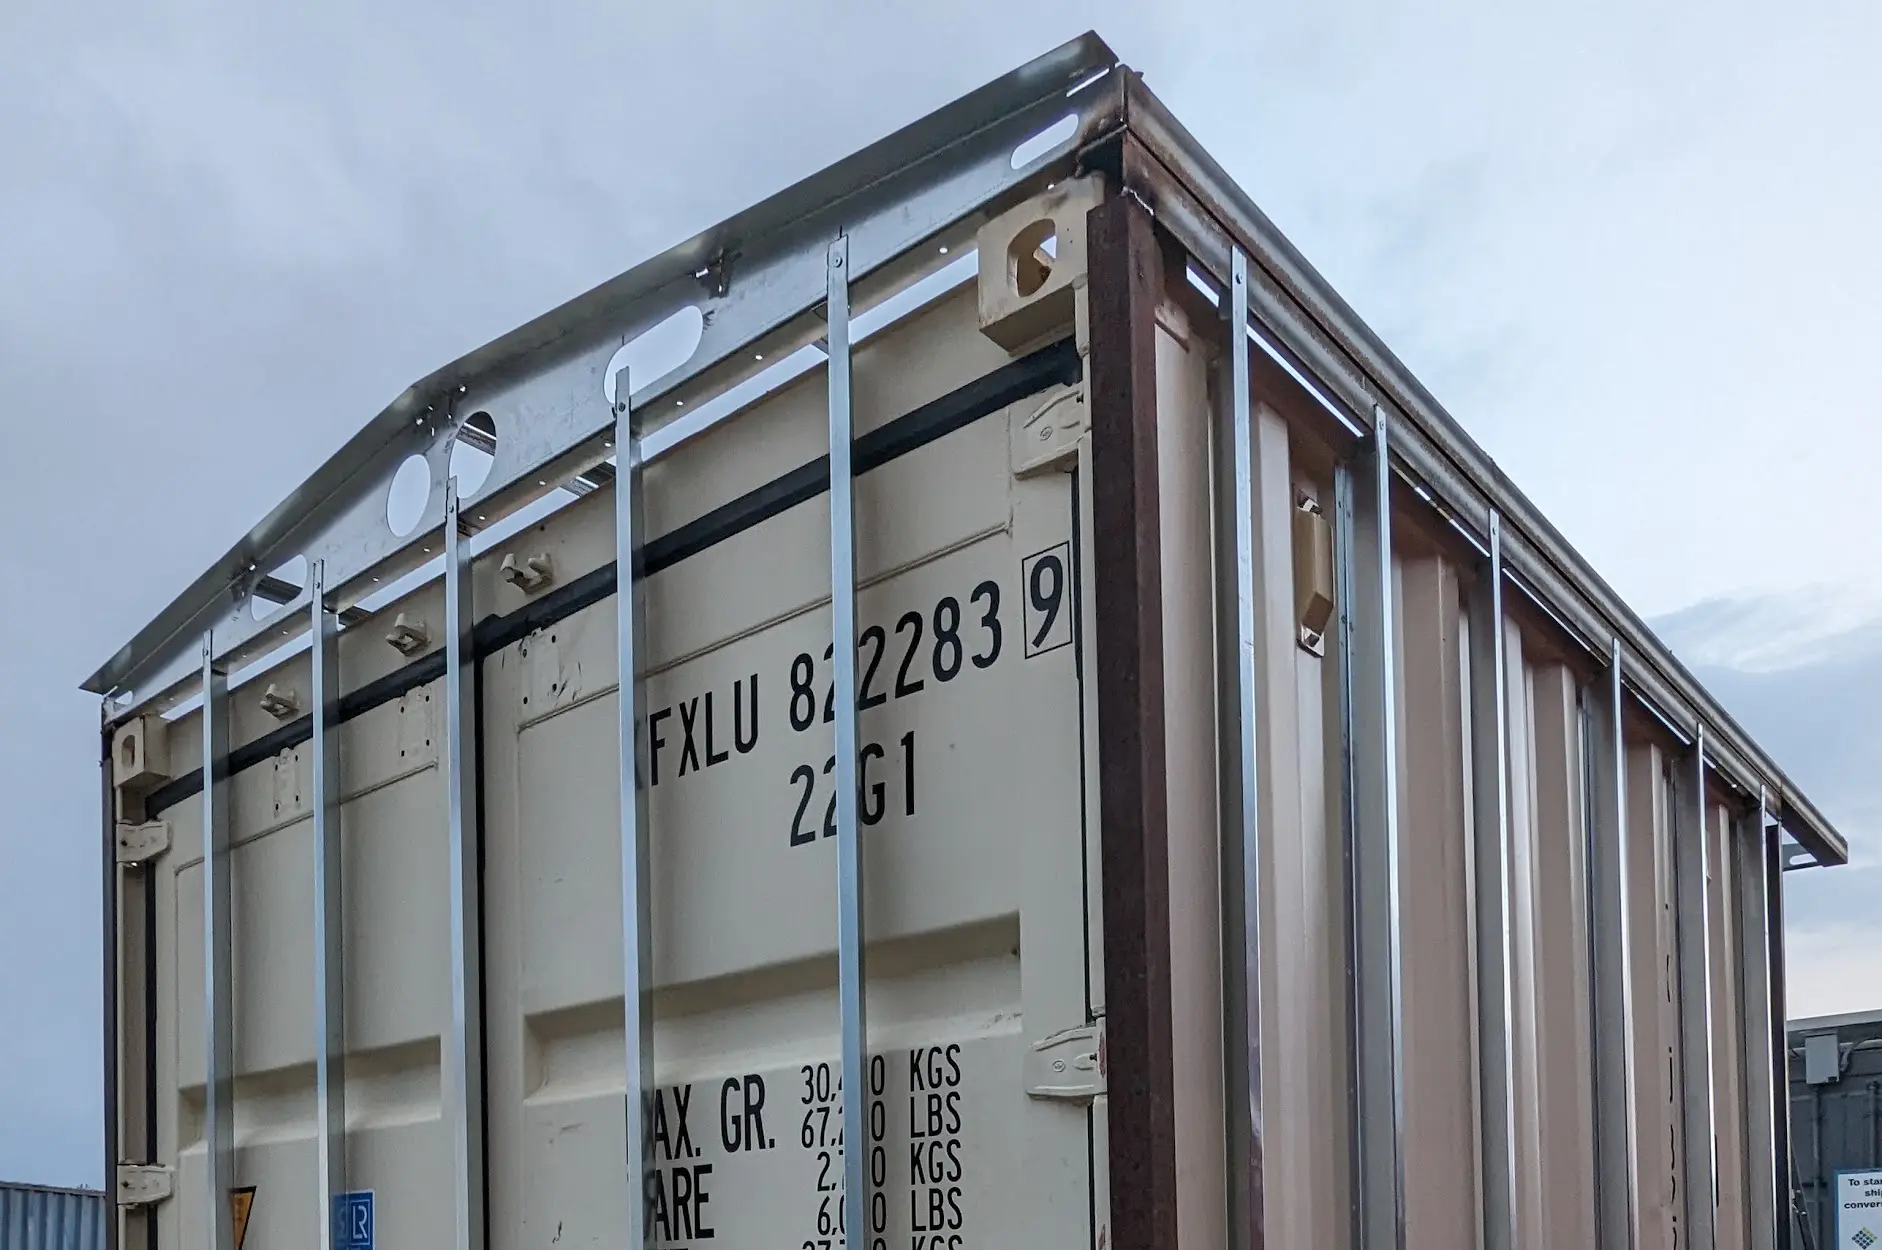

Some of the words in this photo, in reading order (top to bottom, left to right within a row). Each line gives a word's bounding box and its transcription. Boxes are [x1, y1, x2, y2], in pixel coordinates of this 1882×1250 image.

[649, 673, 759, 787] FXLU
[1029, 554, 1064, 650] 9
[625, 1083, 701, 1161] AX.
[720, 1072, 775, 1153] GR.
[909, 1044, 961, 1092] KGS
[909, 1091, 961, 1139] LBS
[910, 1139, 962, 1186] KGS
[1847, 1178, 1860, 1187] To
[628, 1163, 715, 1242] ARE
[911, 1186, 963, 1233] LBS
[1844, 1201, 1882, 1210] conver
